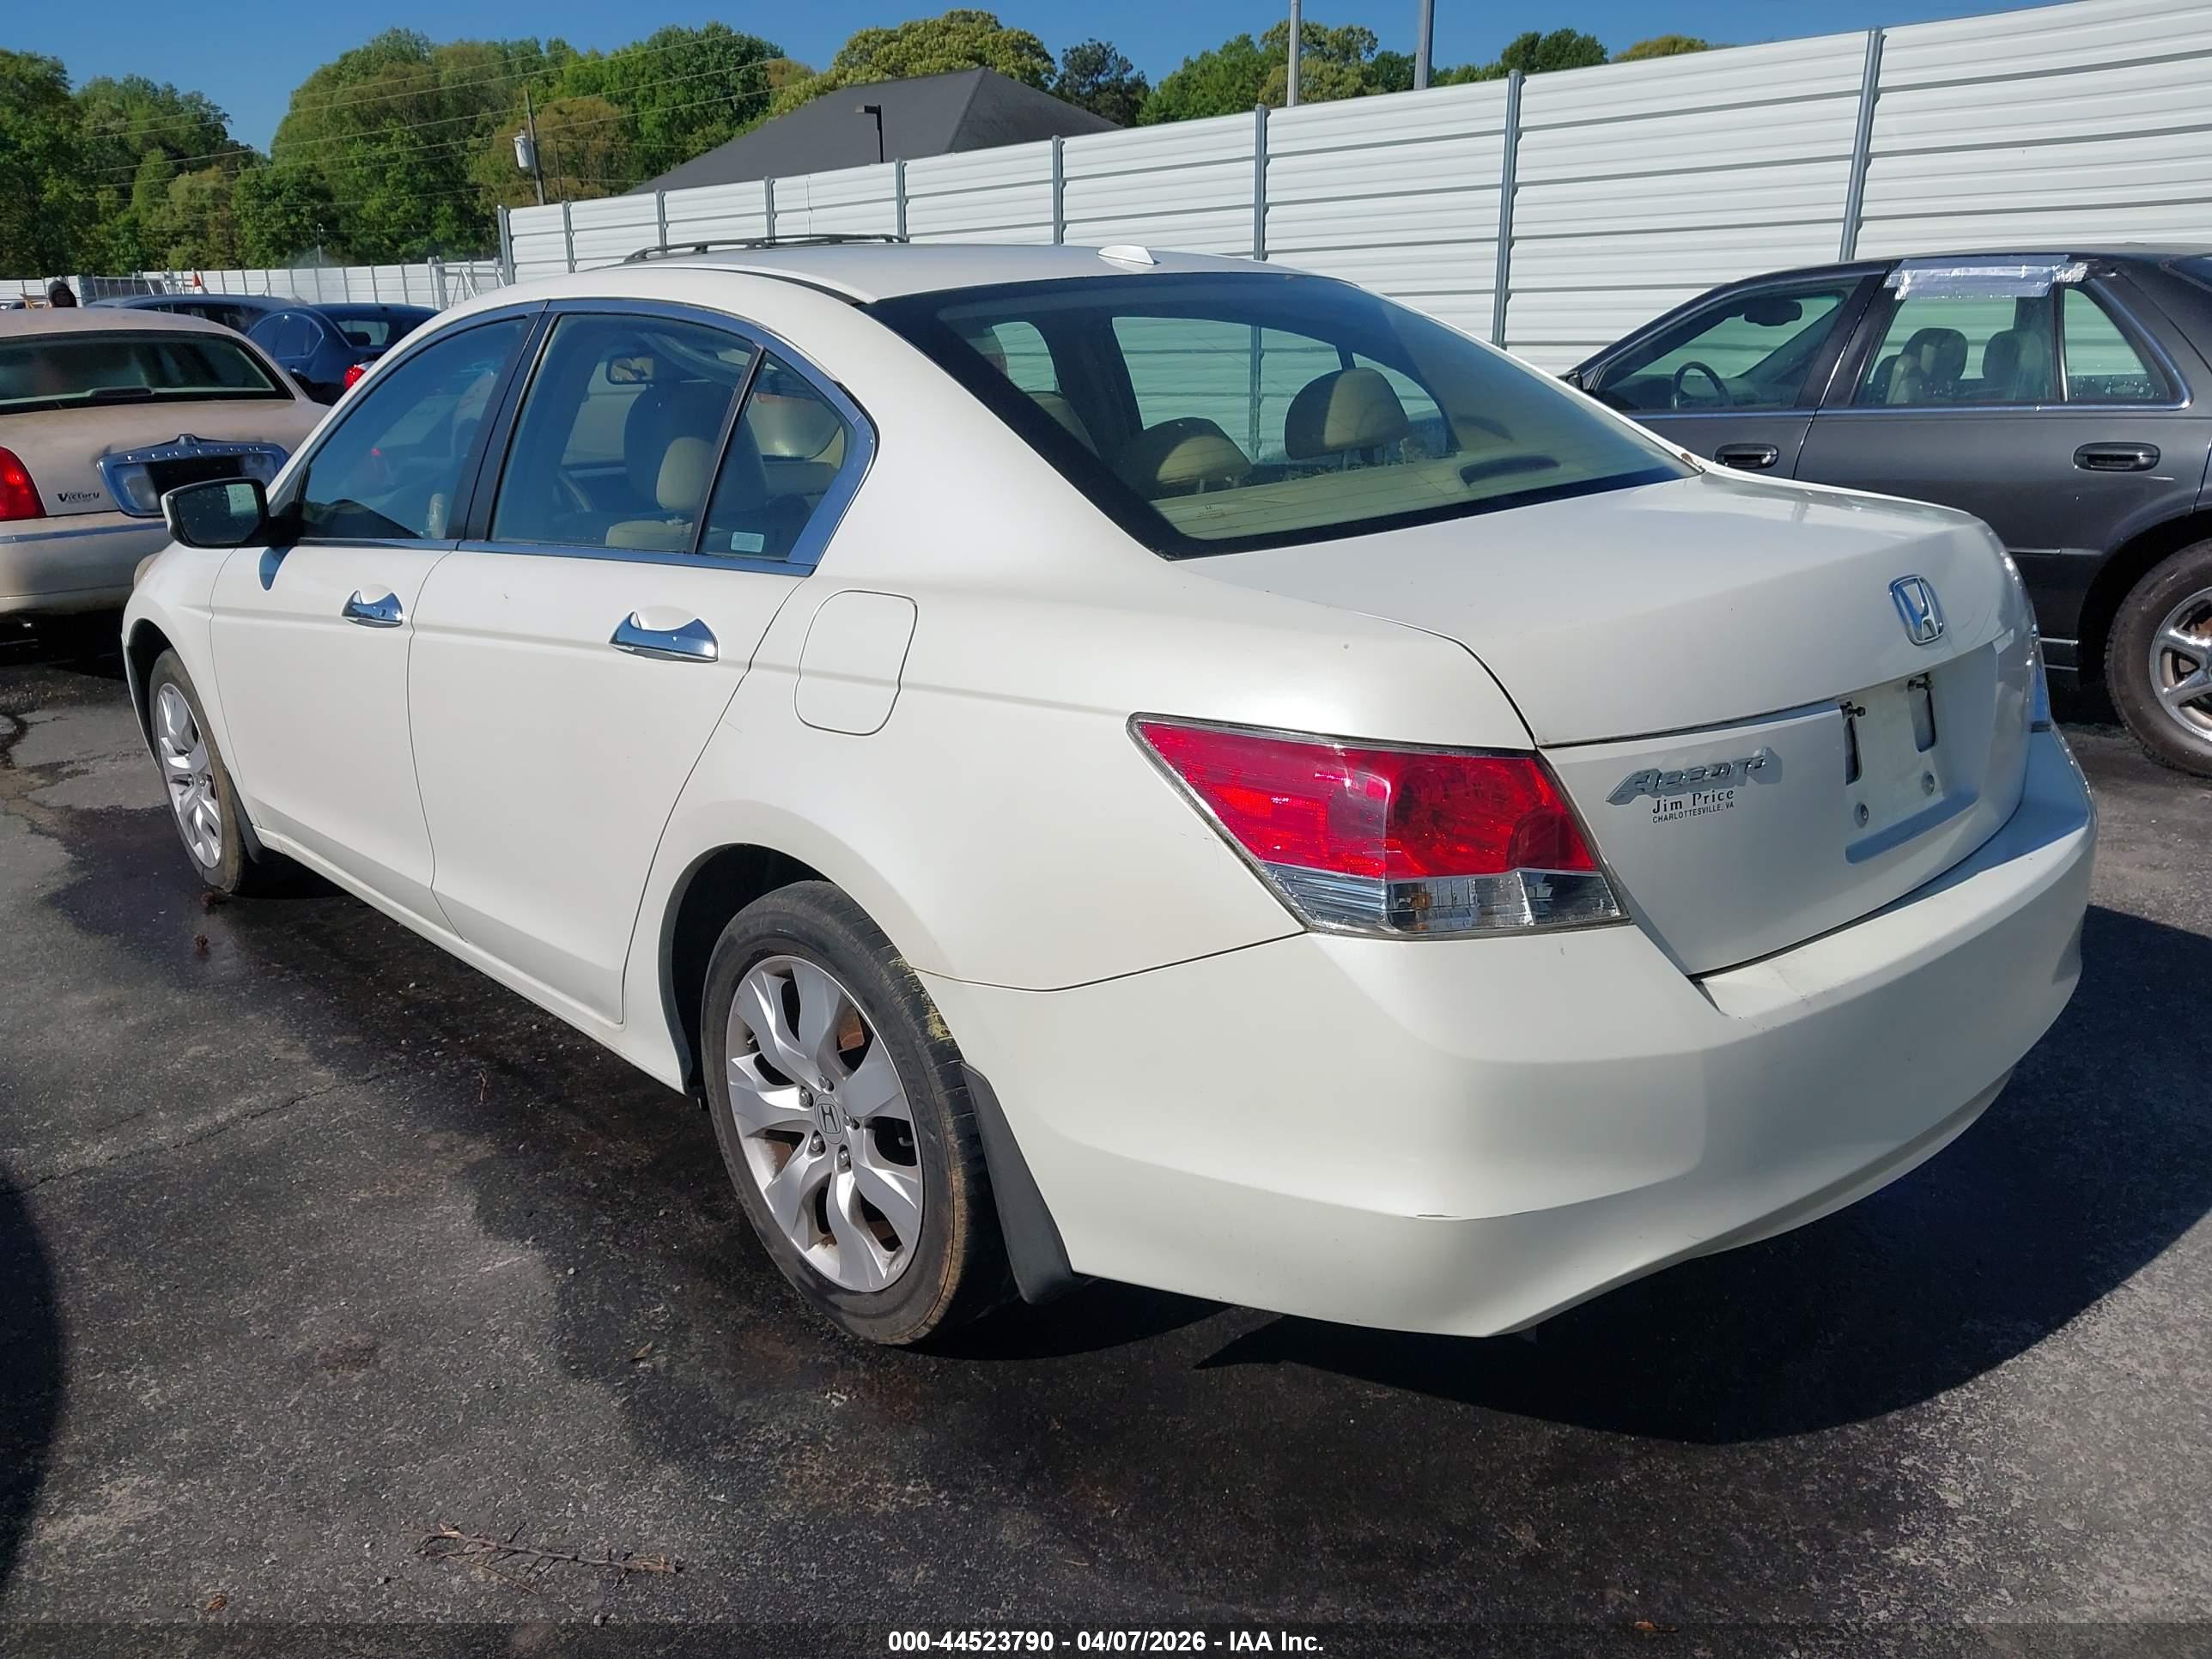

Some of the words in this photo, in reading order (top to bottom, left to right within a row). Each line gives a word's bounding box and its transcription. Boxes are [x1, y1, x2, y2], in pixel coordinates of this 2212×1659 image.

[1605, 747, 1769, 805] Accord
[1652, 799, 1683, 815] Jim
[1692, 789, 1735, 806] Price
[1725, 801, 1735, 810] VA
